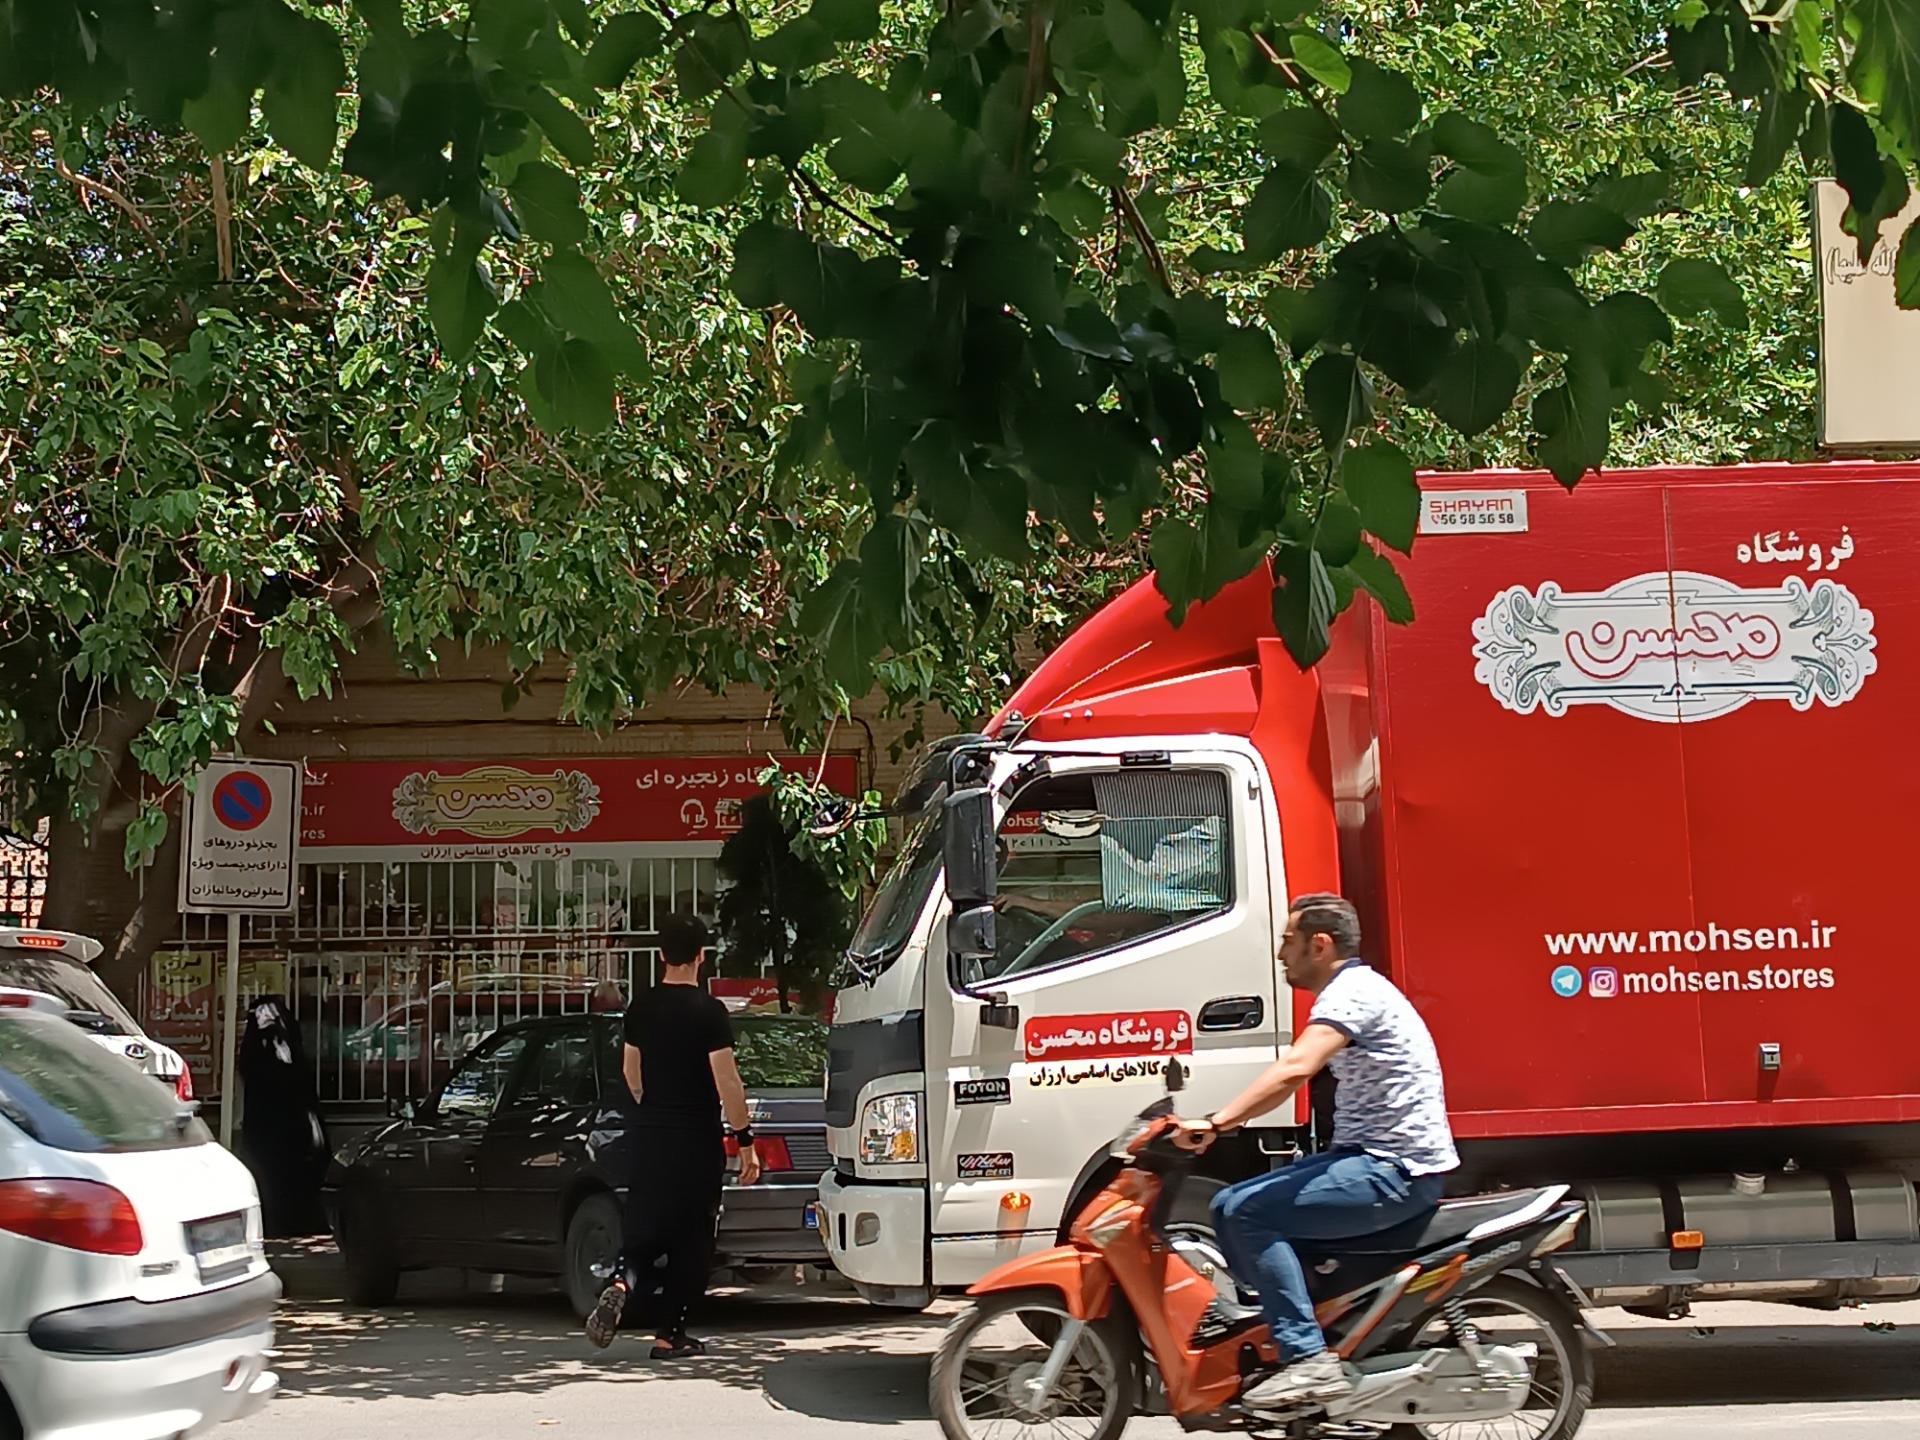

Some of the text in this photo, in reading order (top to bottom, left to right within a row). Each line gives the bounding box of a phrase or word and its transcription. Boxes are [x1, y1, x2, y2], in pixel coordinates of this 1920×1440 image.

[1430, 499, 1513, 513] SHAYAN
[1737, 526, 1855, 572] فروشگاه
[1566, 611, 1781, 680] محسن
[636, 768, 659, 789] ای
[664, 768, 729, 789] زنجیره
[436, 784, 553, 819] محسن
[421, 845, 571, 859] ویژه کالاهای اساسی ارزان
[192, 857, 214, 870] ویژه
[256, 860, 287, 871] دارای
[242, 886, 284, 899] معلولین
[1544, 920, 1836, 955] www.mohsen.ir
[1623, 964, 1836, 993] mohsen.stores
[1027, 1014, 1189, 1056] فروشگاه محسن
[1030, 1065, 1066, 1086] ارزان
[1067, 1063, 1109, 1084] اساسی
[1111, 1061, 1160, 1082] کالاهای
[959, 1081, 1006, 1094] FOTON
